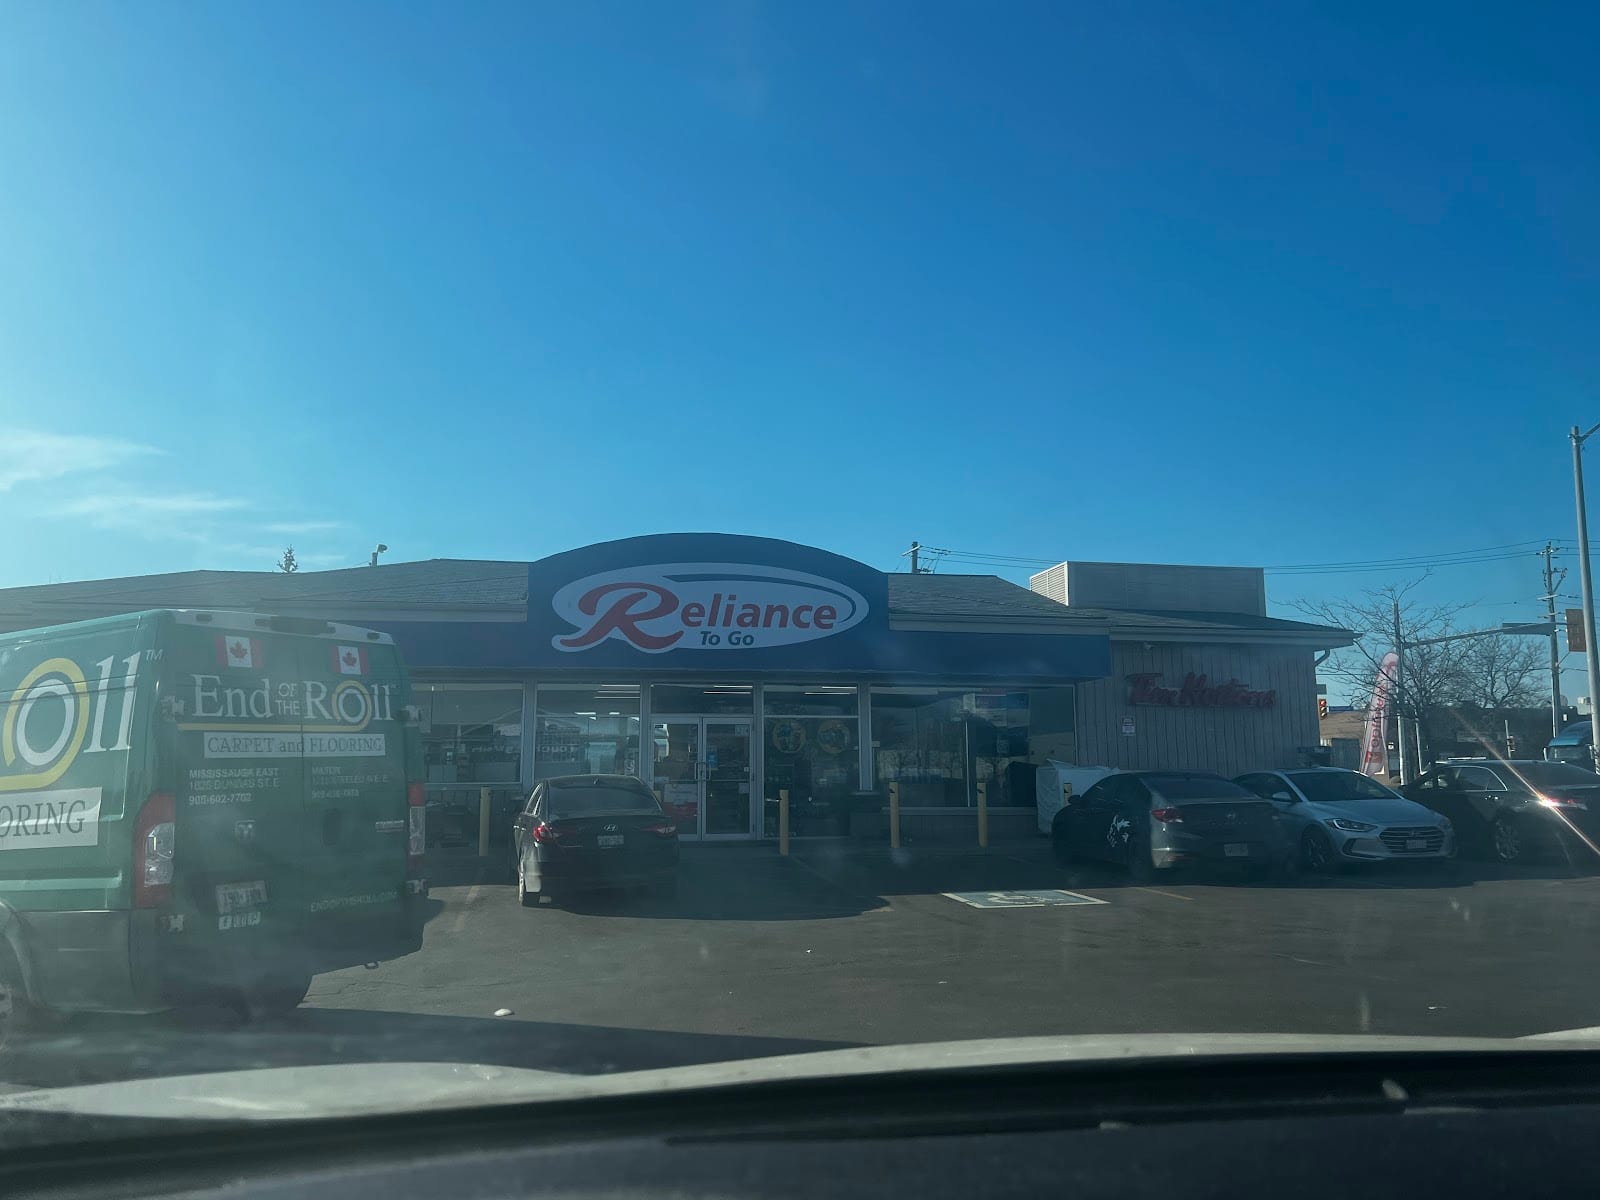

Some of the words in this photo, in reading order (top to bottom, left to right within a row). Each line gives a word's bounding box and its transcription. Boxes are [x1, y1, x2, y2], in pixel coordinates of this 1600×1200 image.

[559, 582, 838, 650] Reliance
[700, 631, 721, 646] To
[728, 632, 754, 646] Go
[191, 674, 274, 719] End
[278, 683, 298, 697] OF
[275, 700, 301, 716] THE
[207, 737, 275, 753] CARPET
[279, 738, 304, 752] and
[309, 737, 382, 752] FLOORING
[256, 767, 279, 777] EAST
